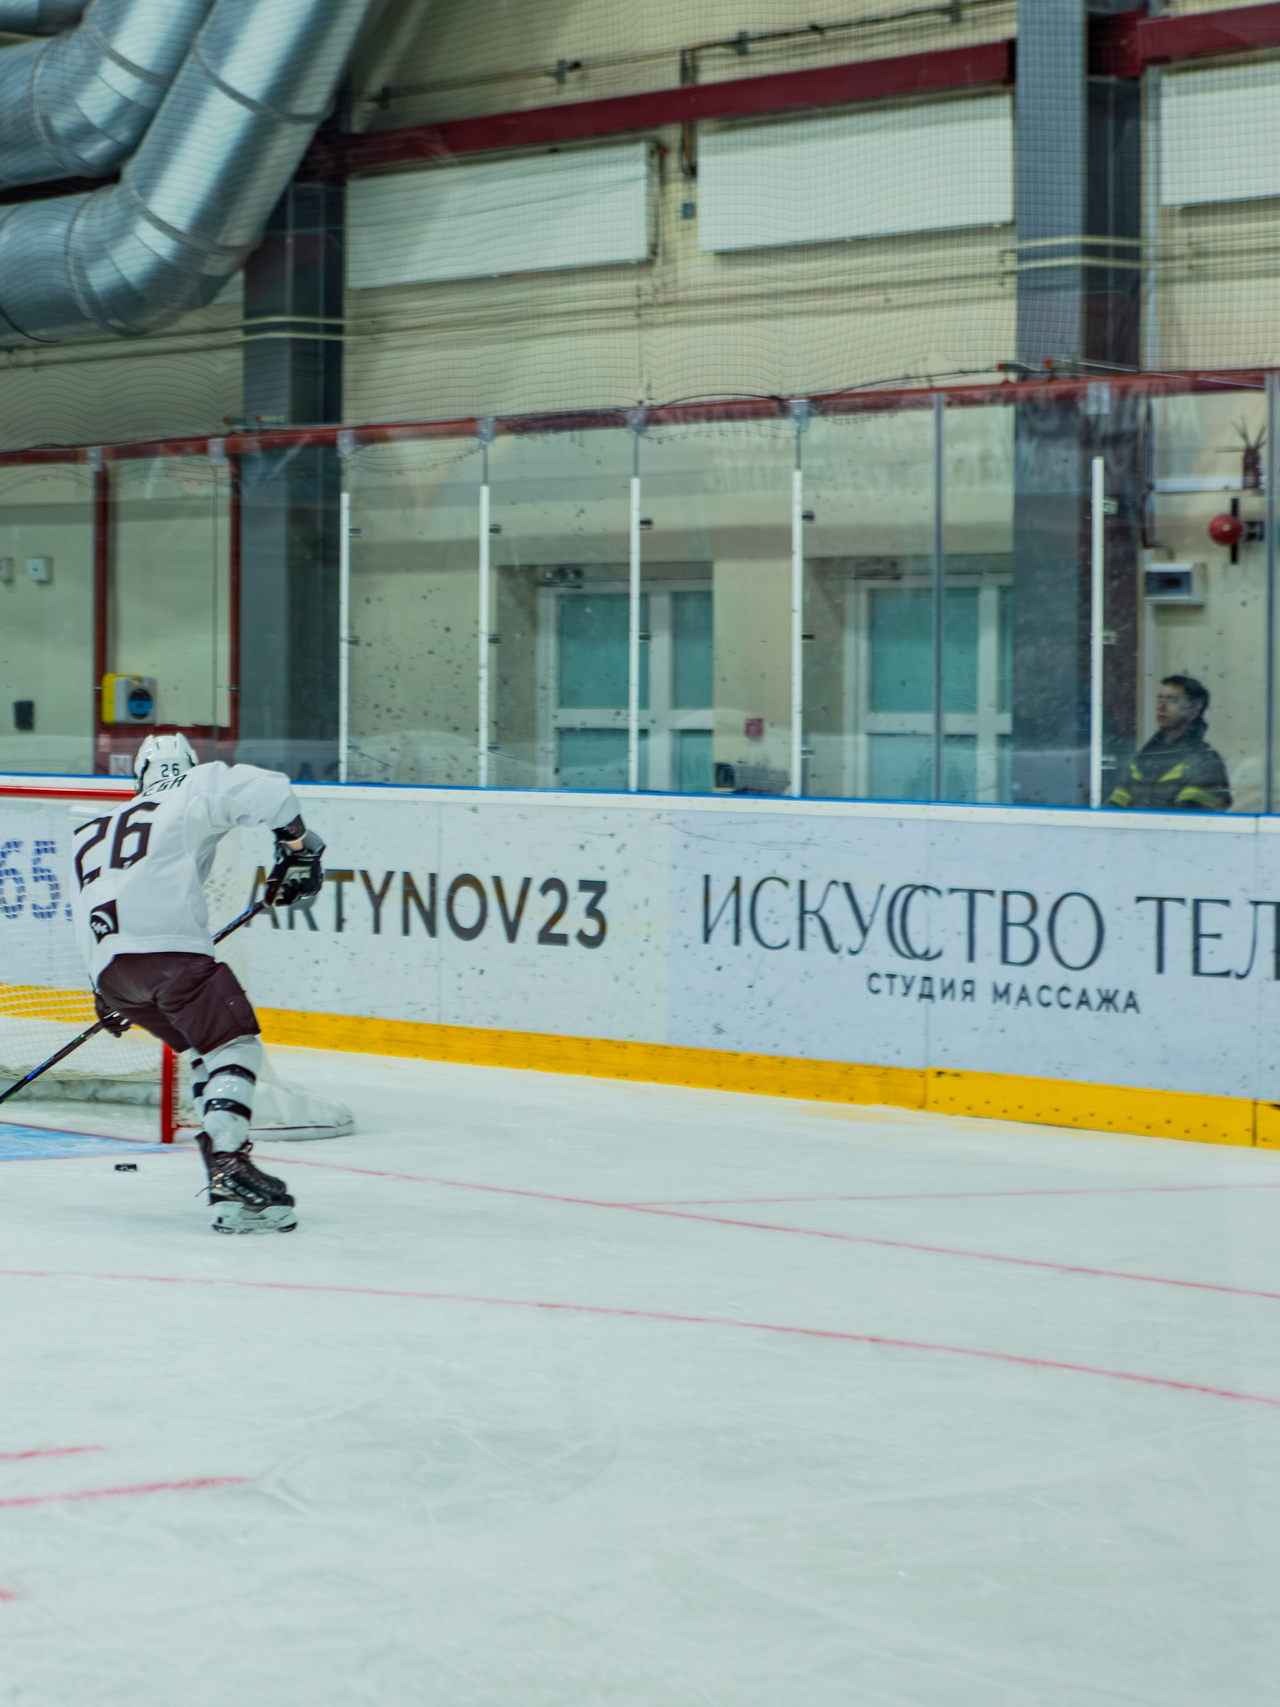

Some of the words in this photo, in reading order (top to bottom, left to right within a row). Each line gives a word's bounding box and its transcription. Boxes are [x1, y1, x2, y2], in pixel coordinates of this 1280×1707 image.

[160, 763, 180, 778] 26
[74, 801, 161, 894] 26
[701, 873, 1105, 972] ИСКУССТВО
[866, 972, 974, 1003] СТУДИЯ
[991, 982, 1141, 1015] МАССАЖА
